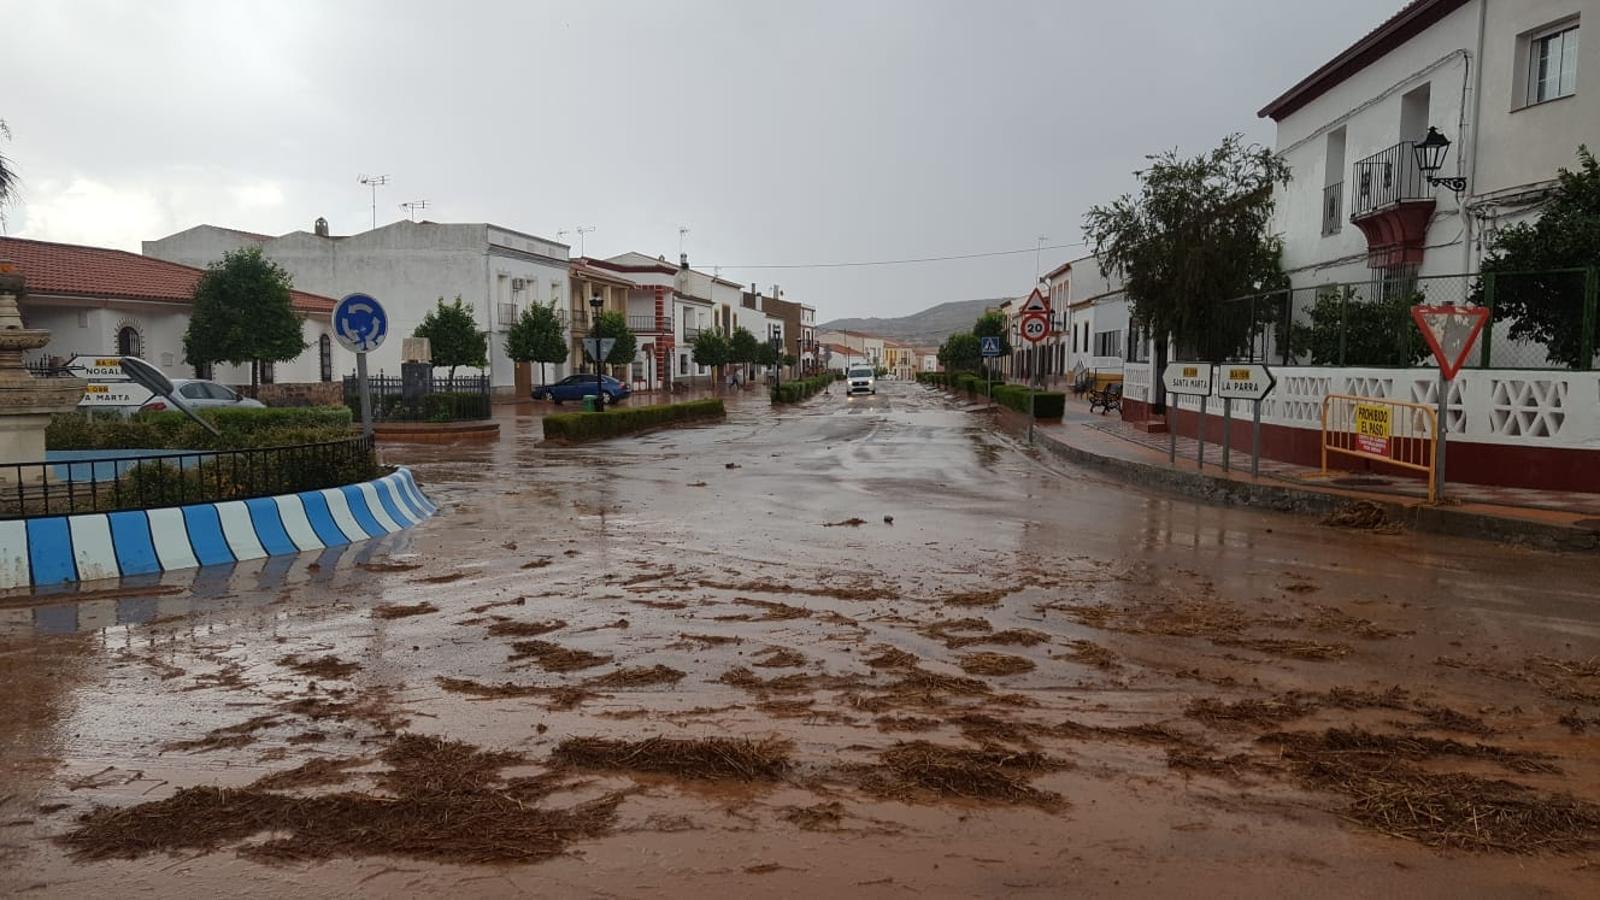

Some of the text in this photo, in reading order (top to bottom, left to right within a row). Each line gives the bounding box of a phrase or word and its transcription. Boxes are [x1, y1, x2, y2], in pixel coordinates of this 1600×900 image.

[1027, 323, 1043, 333] 20
[1172, 378, 1208, 389] SANTA MARTA
[1221, 381, 1259, 392] LA PARRA
[1358, 407, 1388, 423] PROHIBIDO
[1361, 421, 1384, 436] EL PASO
